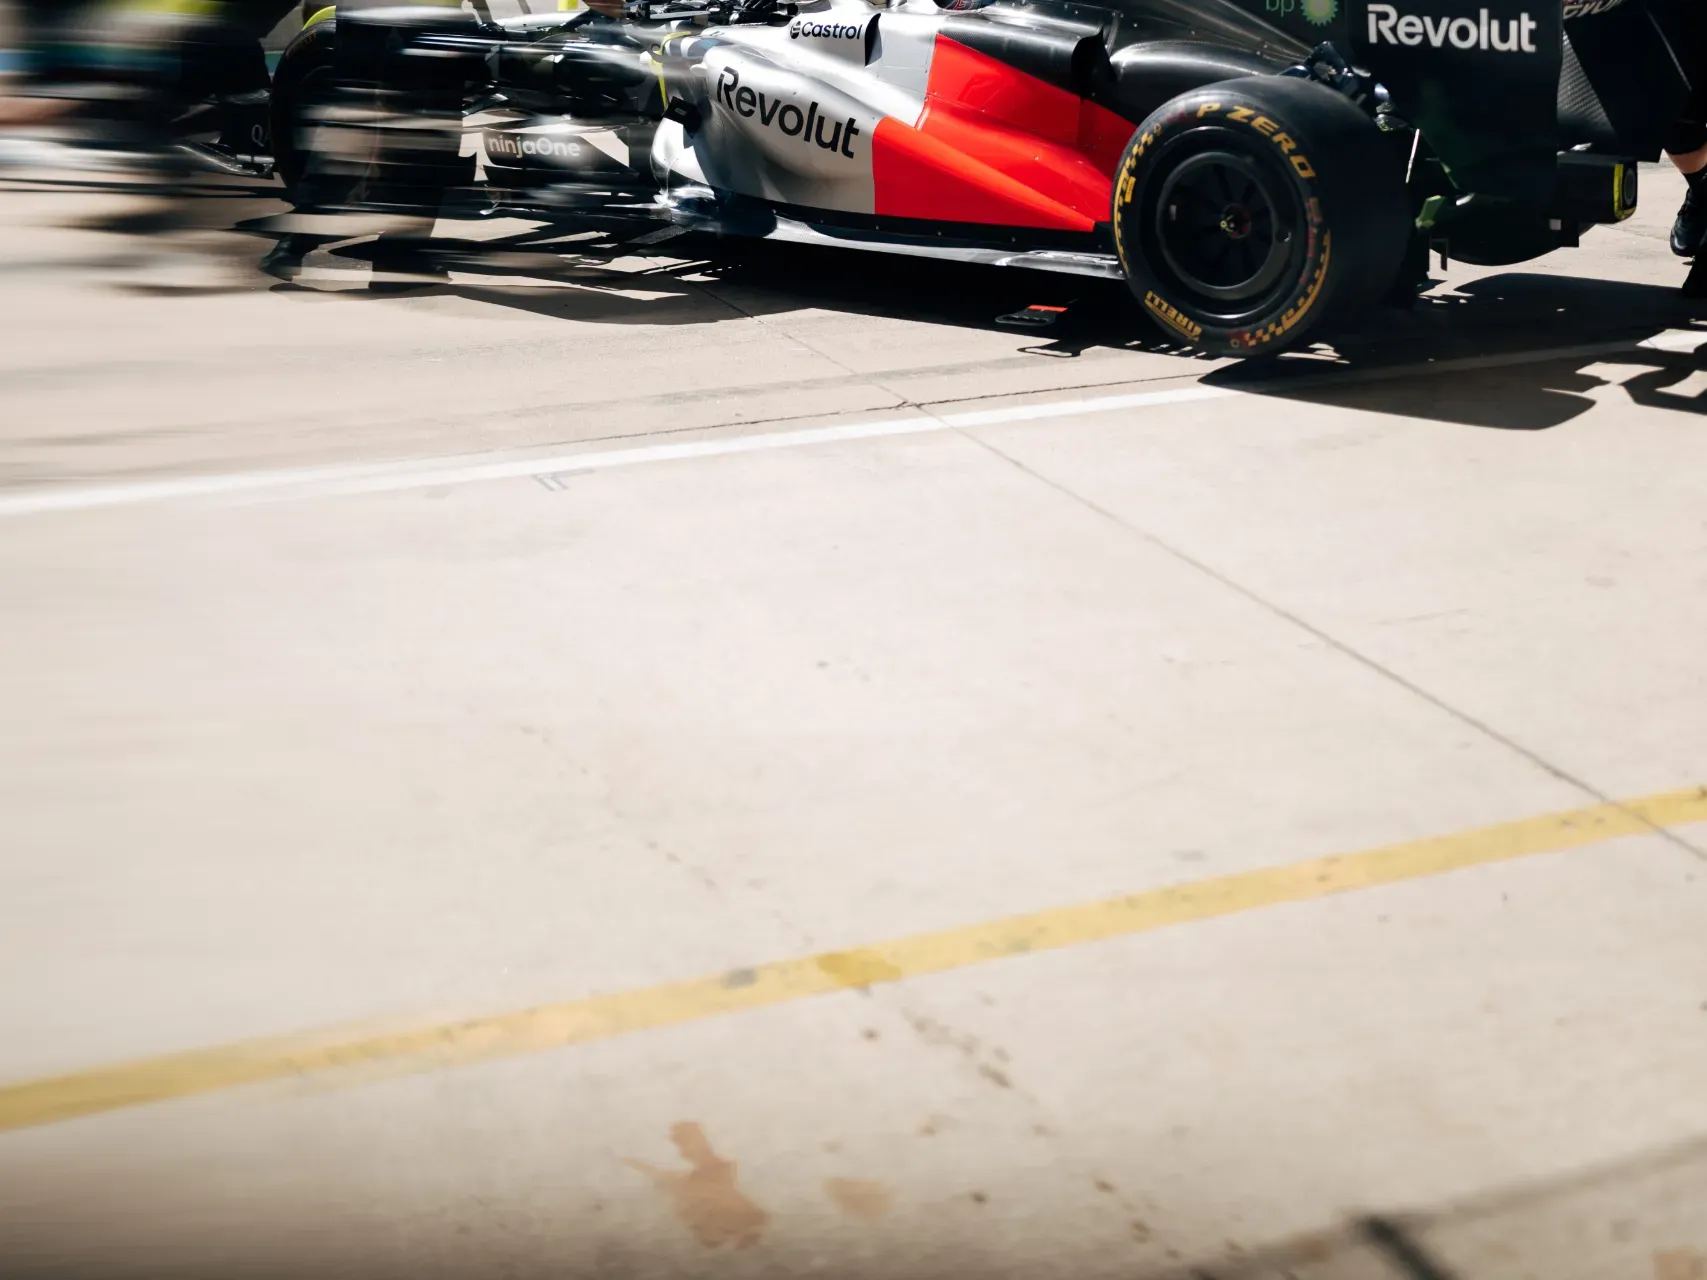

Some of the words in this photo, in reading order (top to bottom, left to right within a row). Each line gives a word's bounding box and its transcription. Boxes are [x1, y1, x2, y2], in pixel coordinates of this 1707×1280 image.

[801, 21, 863, 40] Castrol
[1367, 3, 1537, 53] Revolut
[716, 65, 860, 159] Revolut
[487, 135, 581, 158] ninjaOne
[1196, 102, 1222, 118] P
[1226, 105, 1316, 178] ZERO
[1144, 289, 1203, 342] PIRELLI
